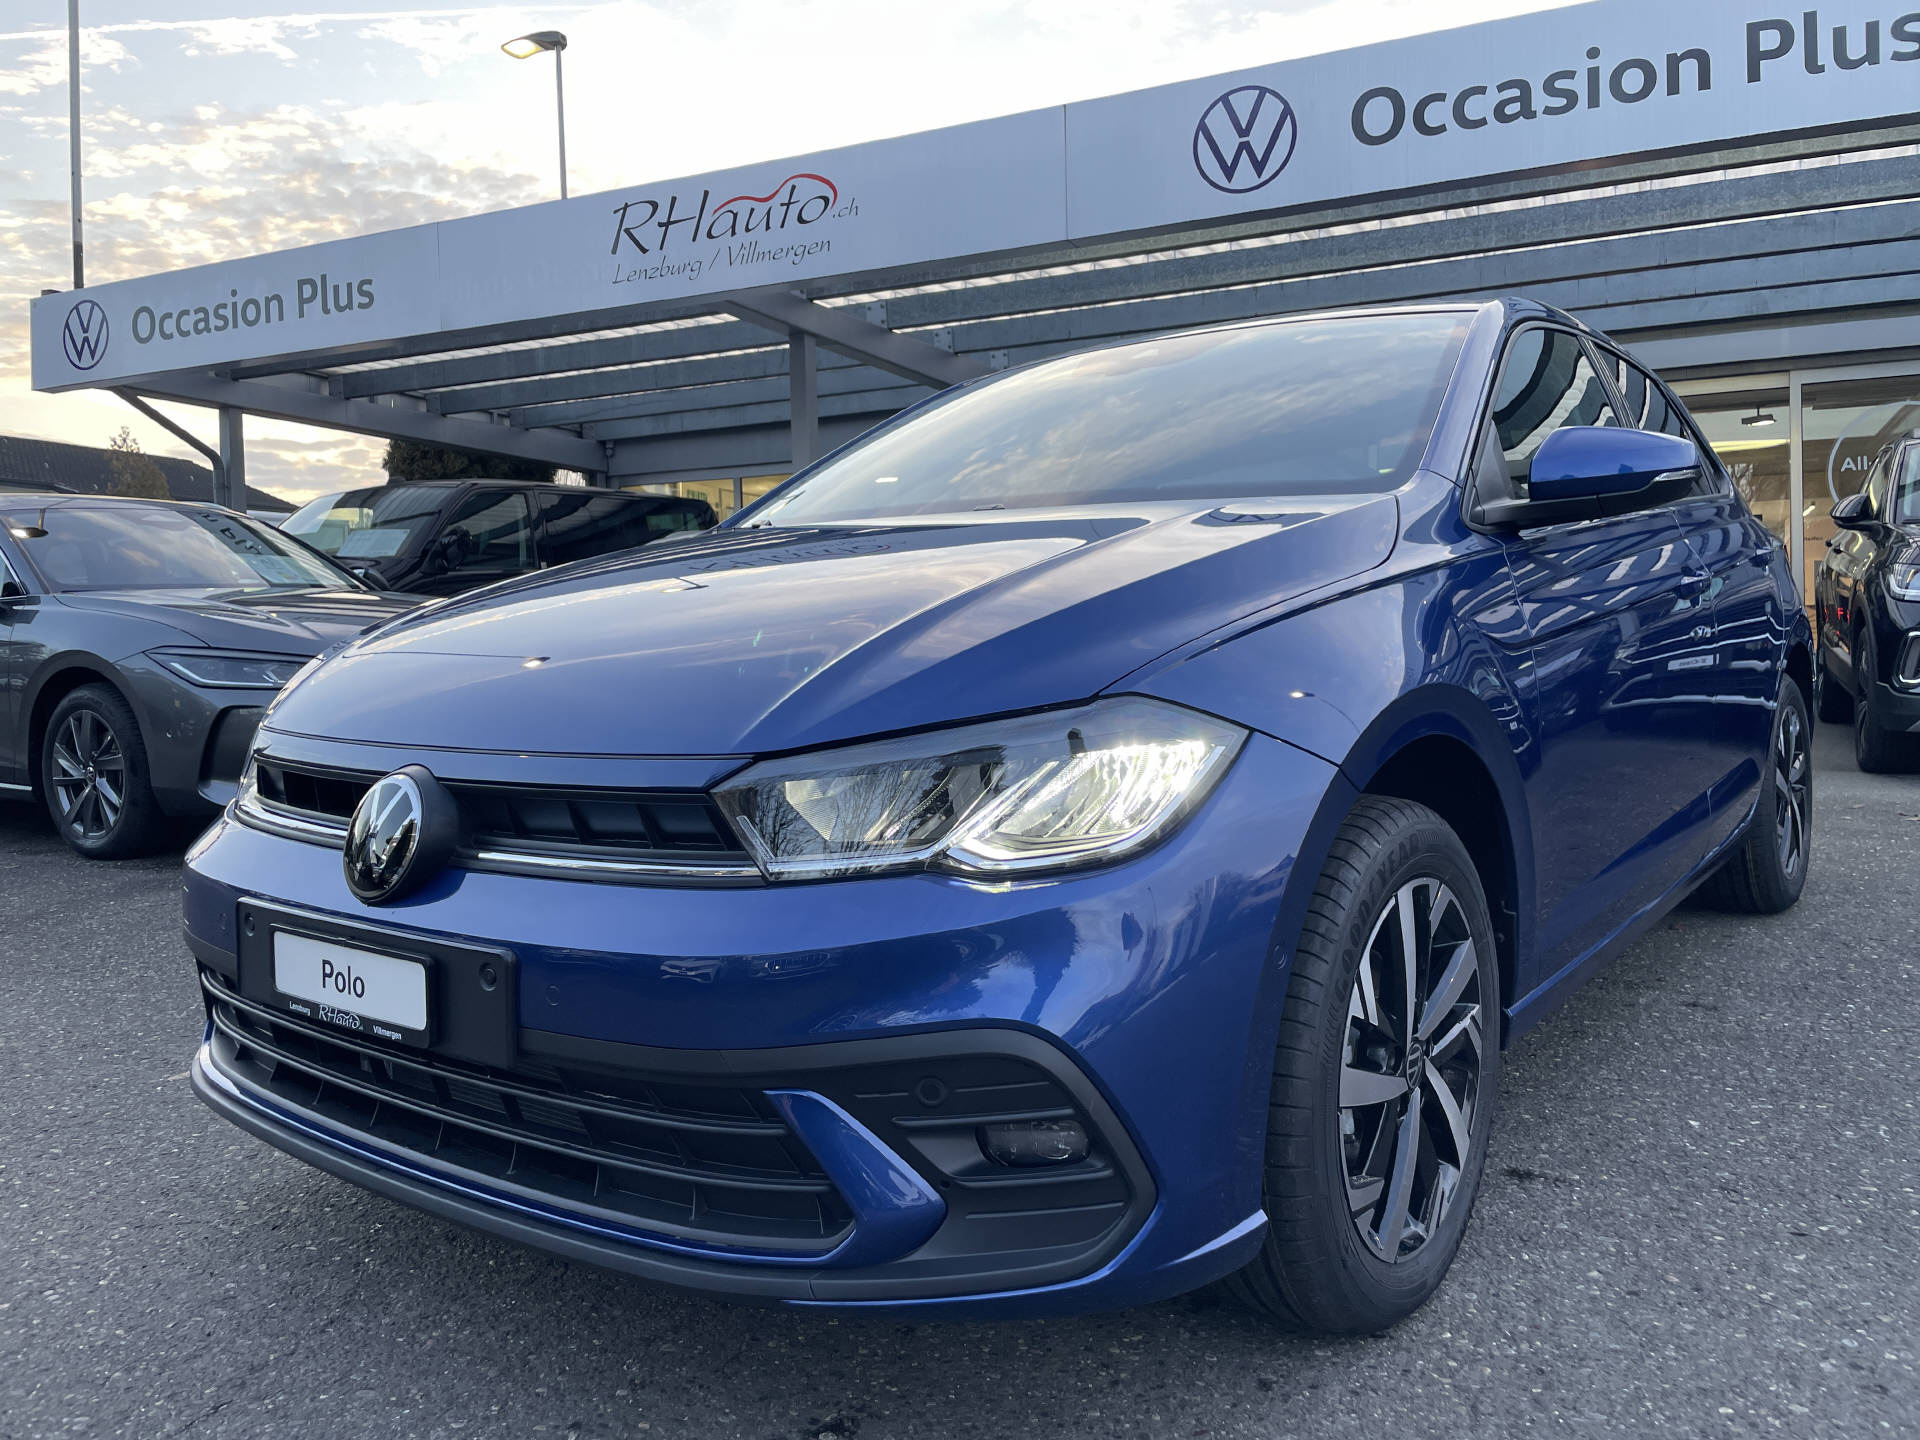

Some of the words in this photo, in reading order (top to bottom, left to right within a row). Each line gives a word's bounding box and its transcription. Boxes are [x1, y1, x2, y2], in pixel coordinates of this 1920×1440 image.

[1351, 46, 1711, 146] Occasion
[1746, 10, 1920, 84] Plus
[612, 256, 702, 285] Lenzburg
[708, 248, 719, 272] /
[728, 241, 831, 274] Villmergen
[132, 289, 284, 345] Occasion
[298, 273, 375, 319] Plus
[322, 959, 365, 999] Polo
